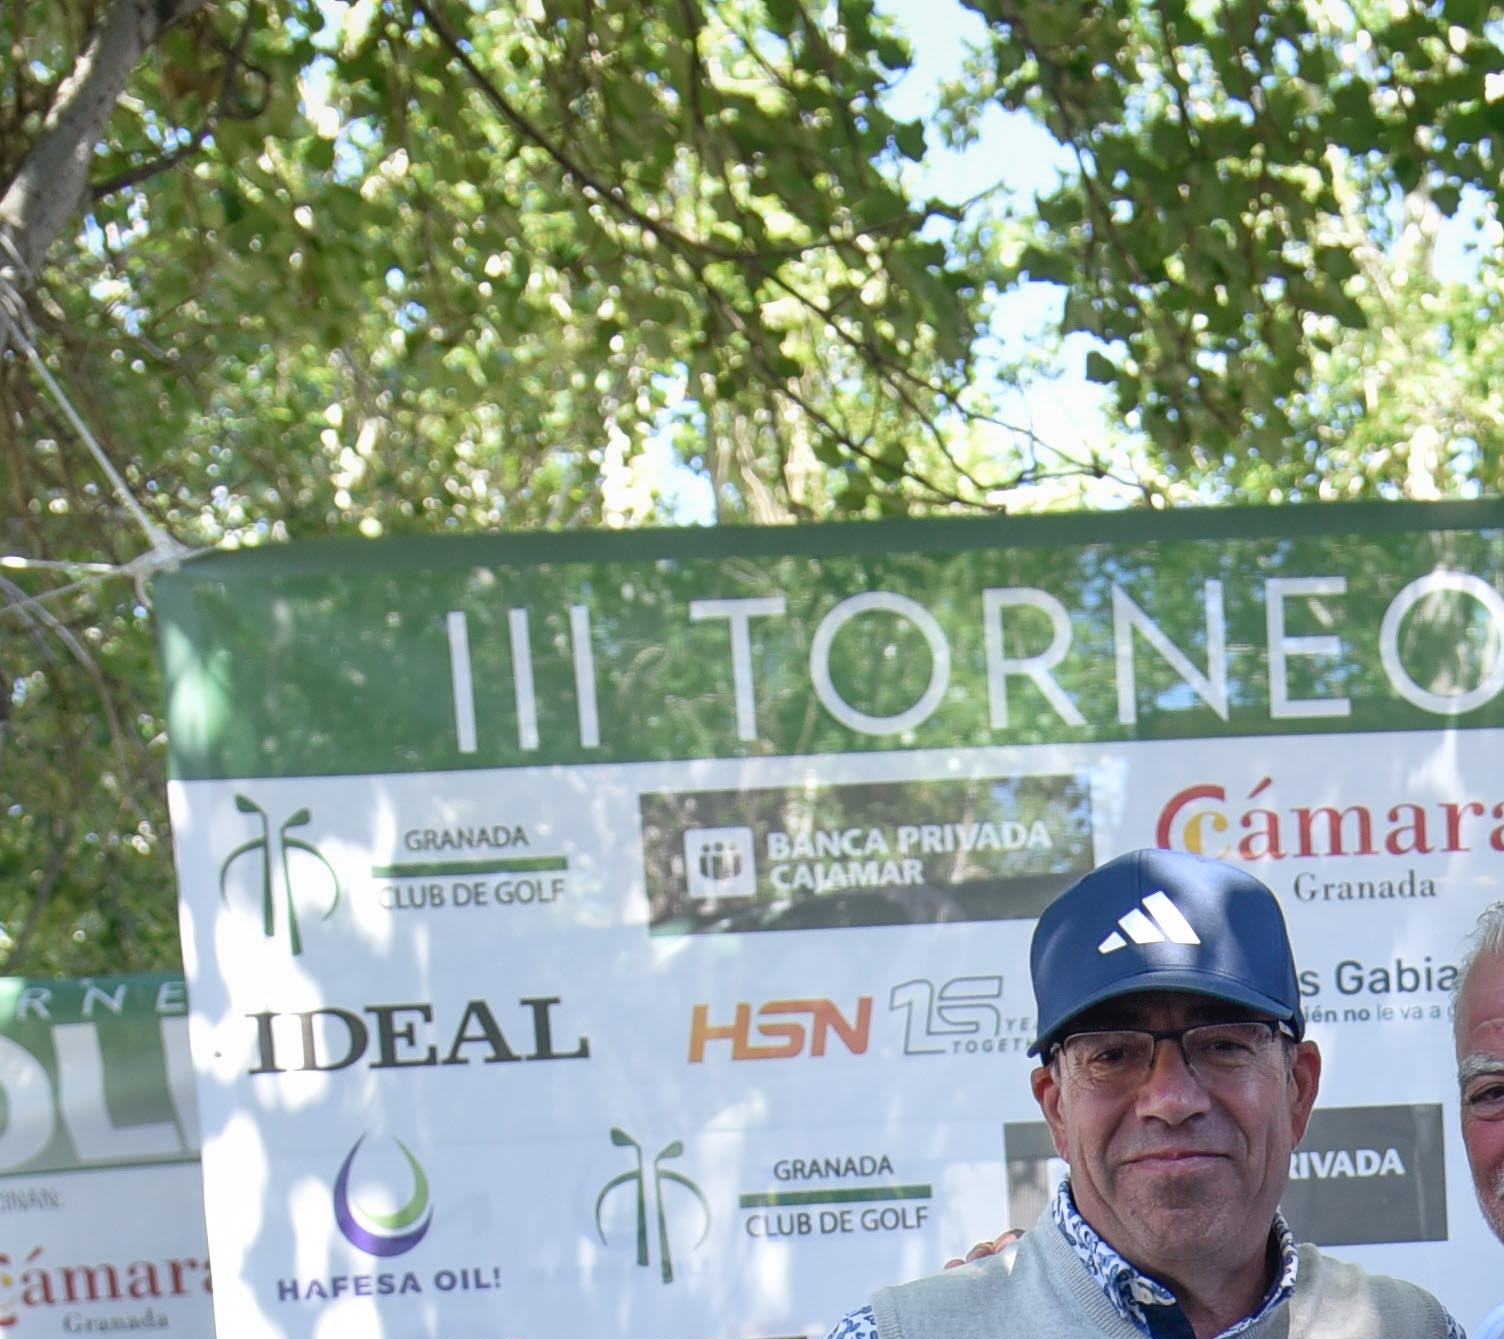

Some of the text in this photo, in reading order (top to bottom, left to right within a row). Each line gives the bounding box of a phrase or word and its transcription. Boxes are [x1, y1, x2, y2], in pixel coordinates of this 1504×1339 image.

[446, 604, 600, 752] III
[404, 827, 529, 852] GRANADA
[768, 820, 1053, 862] BANCA PRIVADA
[769, 859, 925, 893] CAJAMAR
[1294, 870, 1436, 902] Granada
[381, 879, 565, 911] CLUB DE GOLF
[1335, 956, 1462, 995] Gabia
[1305, 1004, 1337, 1022] ién
[1343, 1008, 1370, 1021] no
[1376, 1004, 1394, 1020] le
[247, 997, 590, 1074] IDEAL
[689, 996, 873, 1064] HSN
[953, 1038, 1032, 1053] TOGET
[773, 1154, 894, 1180] GRANADA
[1289, 1148, 1405, 1180] IVADA
[746, 1205, 929, 1238] CLUB DE GOLF
[277, 1266, 501, 1302] HAFESA OIL!
